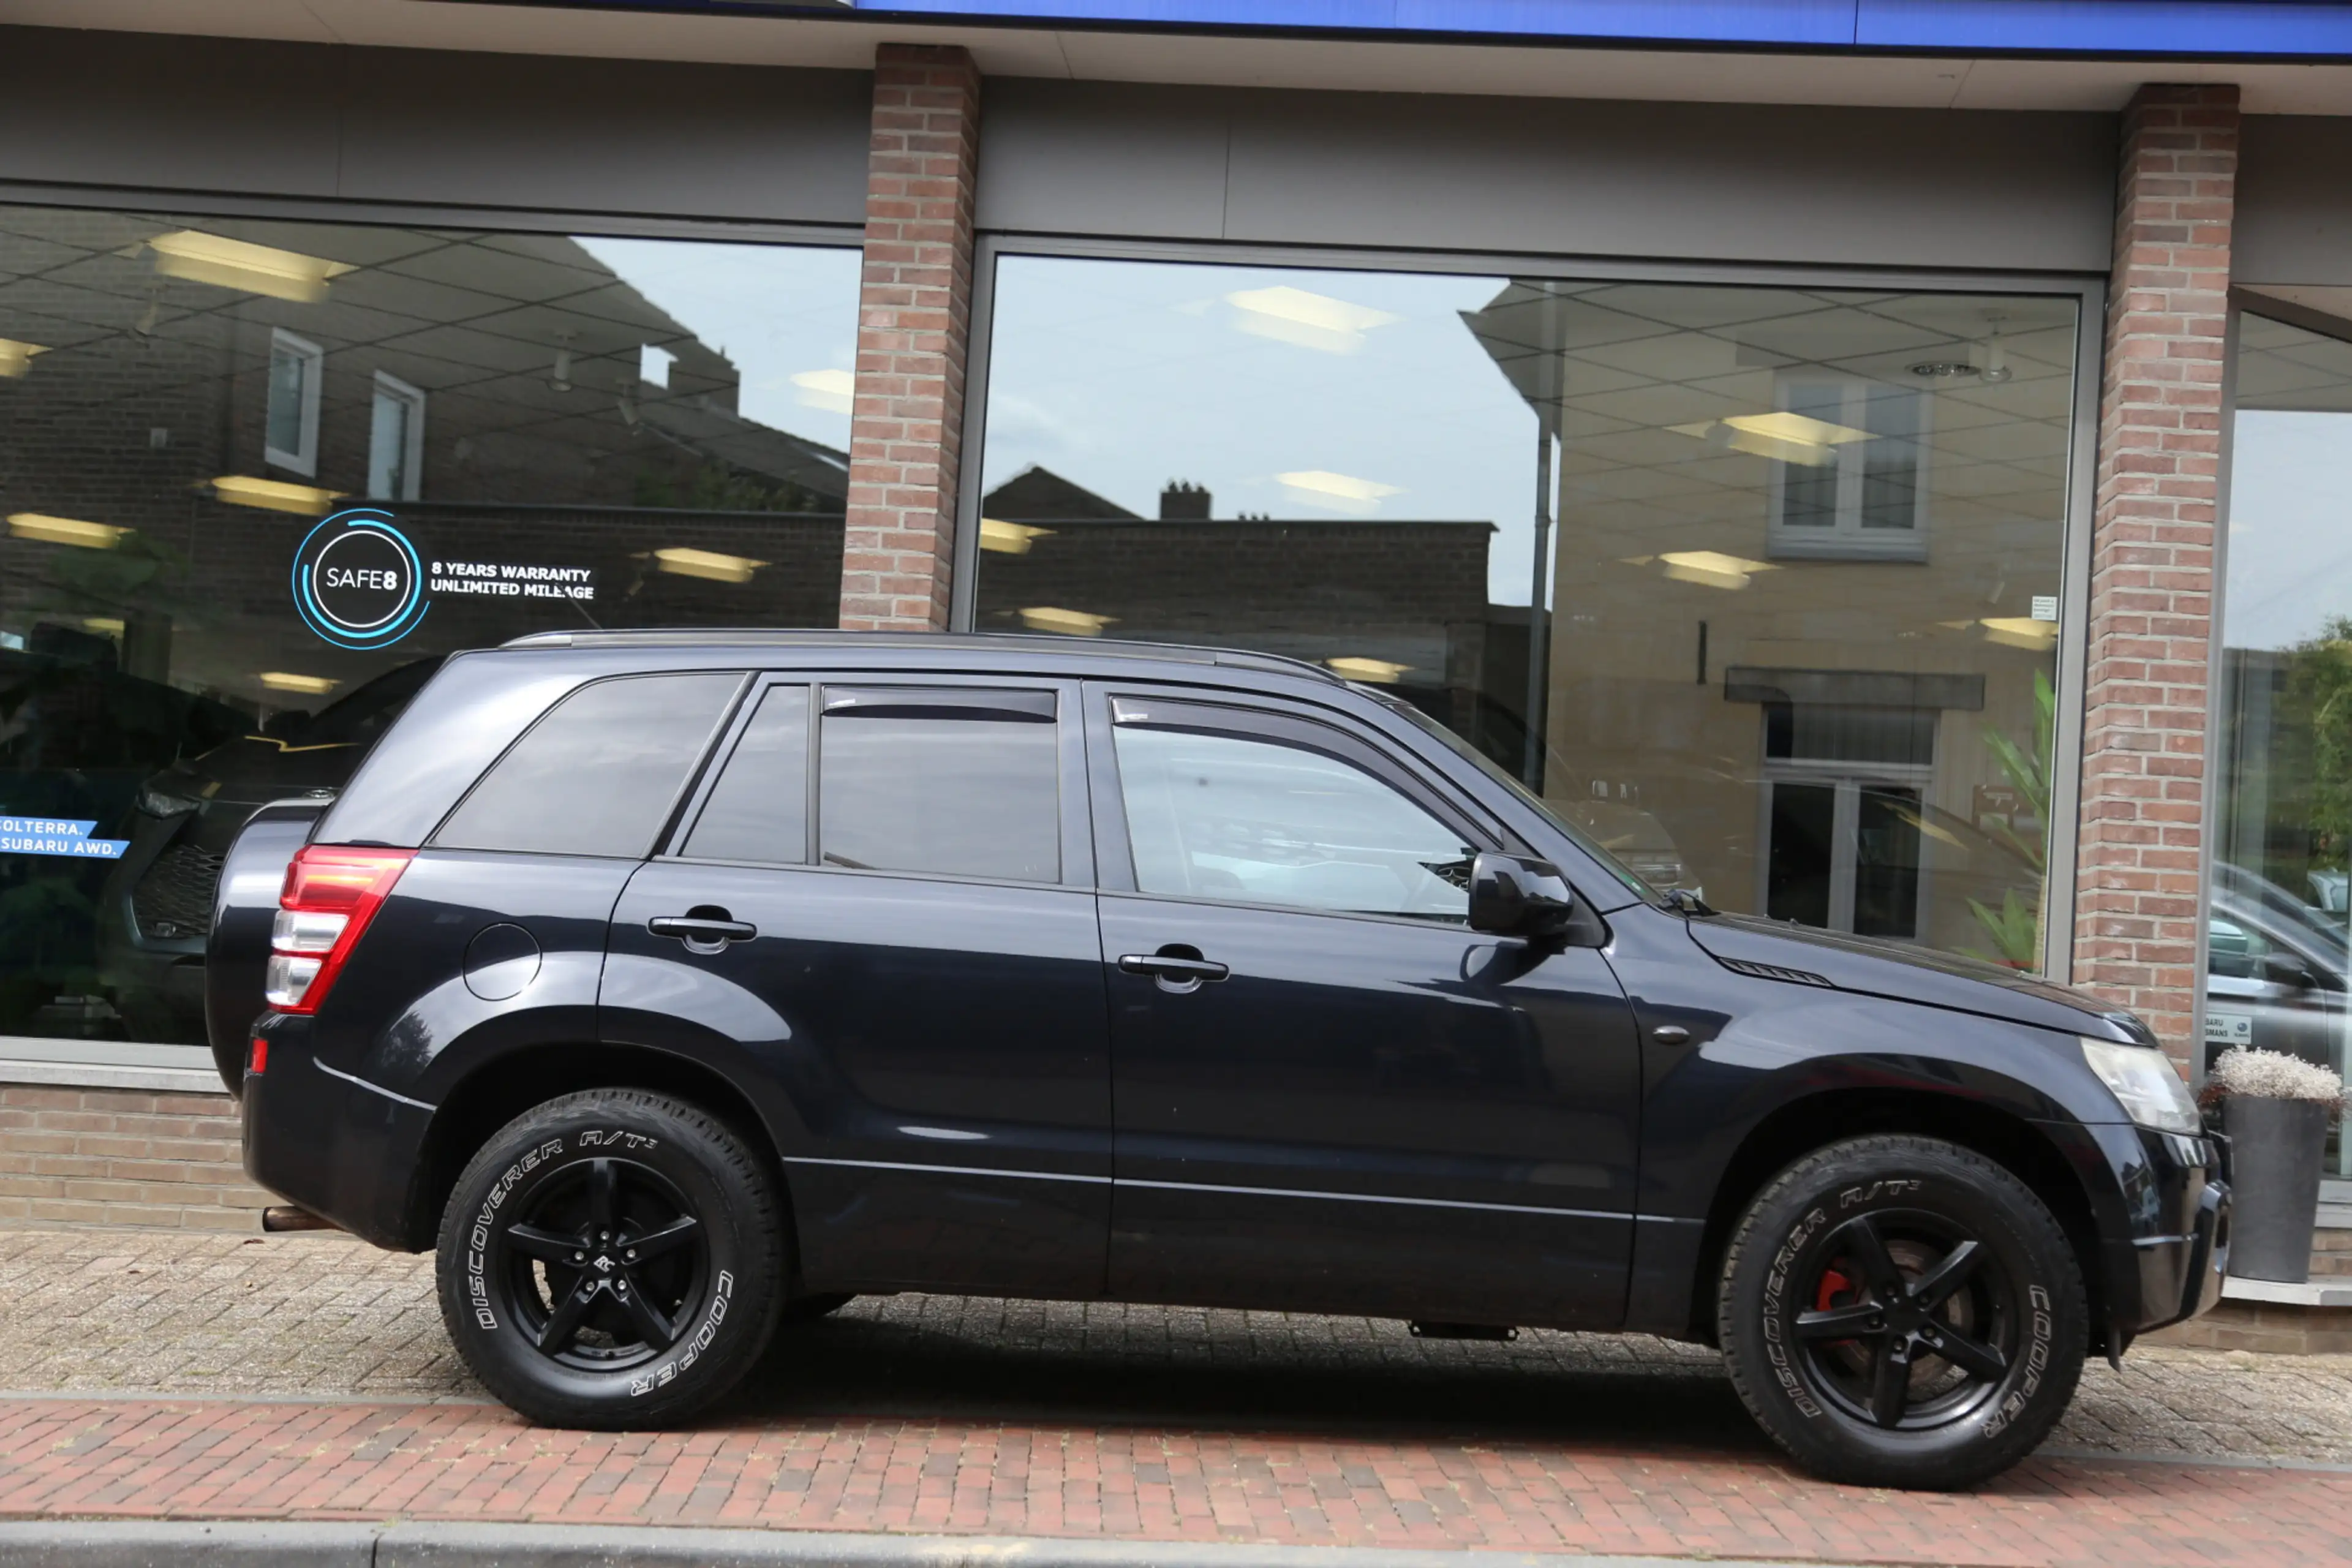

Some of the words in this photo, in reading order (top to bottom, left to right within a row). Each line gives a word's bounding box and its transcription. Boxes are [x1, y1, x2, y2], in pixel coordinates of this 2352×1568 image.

[326, 567, 398, 590] SAFE8
[431, 562, 442, 575] 8
[446, 562, 497, 578] YEARS
[500, 565, 591, 582] WARRANTY
[431, 579, 520, 595] UNLIMITED
[1, 837, 68, 853] SUBARU
[74, 842, 117, 856] AWD.
[468, 1138, 563, 1330] DISCOVERER
[630, 1269, 734, 1396] COOPER
[1763, 1208, 1826, 1418] DISCOVERER
[1981, 1284, 2052, 1439] COOPER
